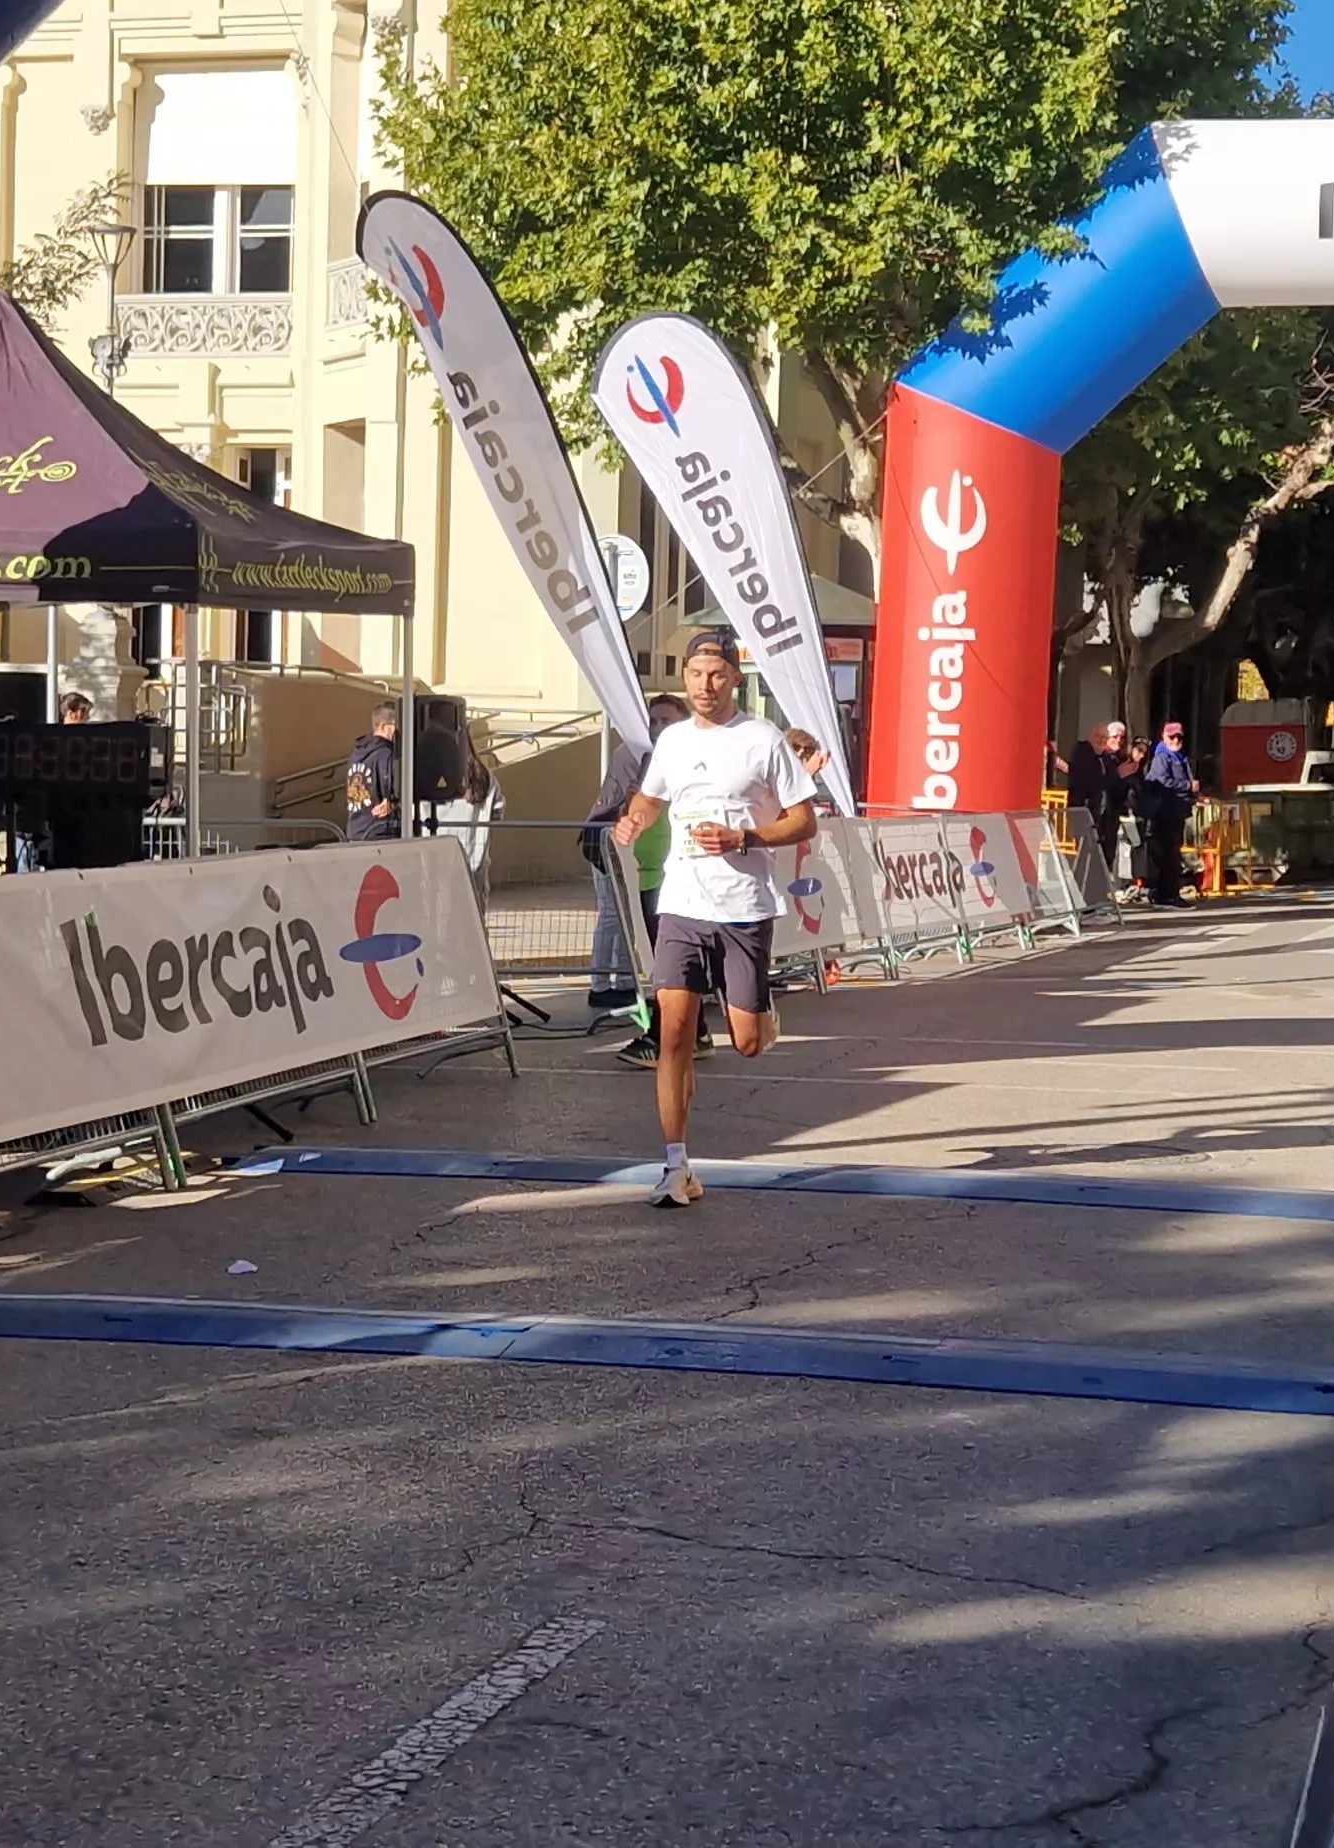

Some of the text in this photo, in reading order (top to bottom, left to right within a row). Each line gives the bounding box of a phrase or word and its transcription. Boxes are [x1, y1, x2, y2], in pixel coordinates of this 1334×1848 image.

[232, 552, 393, 603] www.fartlecksport.com
[912, 590, 976, 810] bercaja
[60, 884, 334, 1047] Ibercaja
